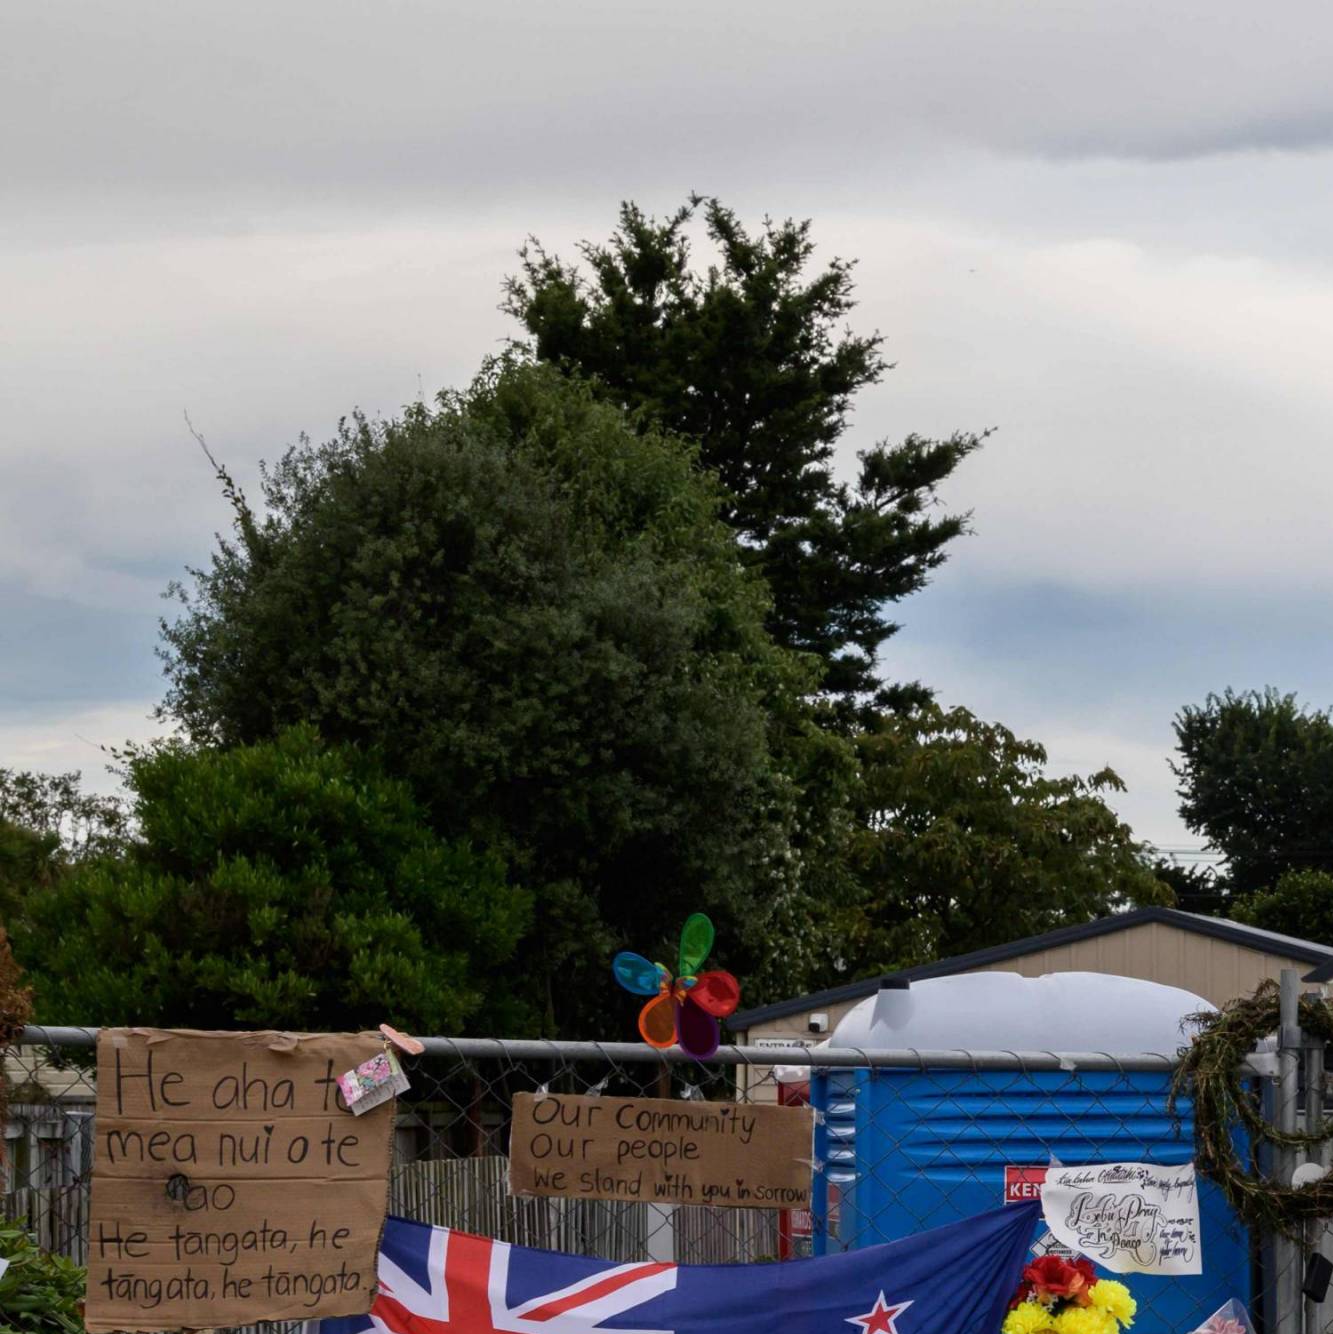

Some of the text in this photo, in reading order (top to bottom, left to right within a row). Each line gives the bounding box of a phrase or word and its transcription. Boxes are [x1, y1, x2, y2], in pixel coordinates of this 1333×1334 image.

[115, 1048, 295, 1114] He aha
[532, 1097, 756, 1144] Our Community
[107, 1122, 360, 1166] mea nui o te
[530, 1133, 700, 1165] Our people
[184, 1183, 235, 1211] ao
[534, 1168, 567, 1191] We
[654, 1171, 692, 1198] with
[702, 1183, 731, 1203] you
[736, 1179, 749, 1199] in
[100, 1222, 149, 1259] He
[309, 1219, 350, 1250] he
[222, 1268, 250, 1299] he
